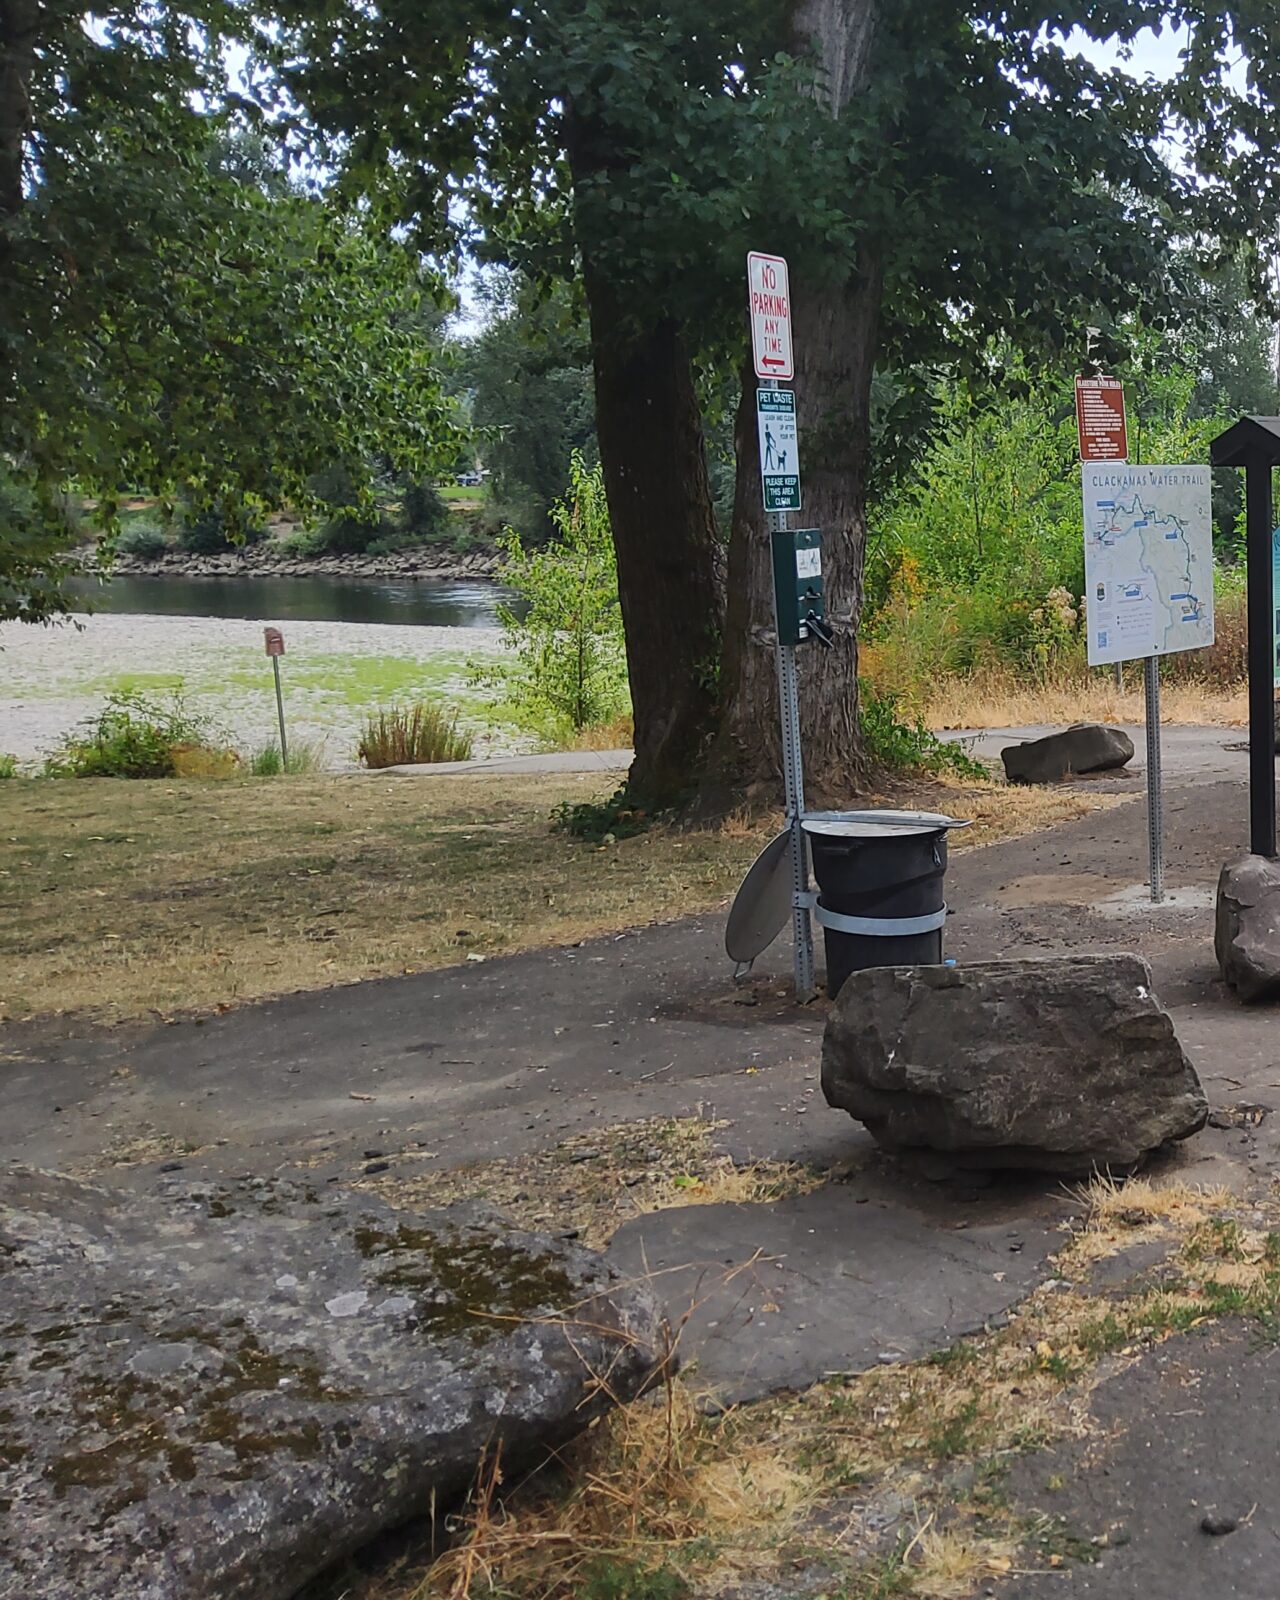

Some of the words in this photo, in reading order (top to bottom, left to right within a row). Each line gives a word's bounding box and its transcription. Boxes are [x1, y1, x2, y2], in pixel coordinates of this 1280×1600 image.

[762, 268, 775, 289] NO
[753, 293, 786, 317] PARKING
[765, 320, 778, 334] ANY
[764, 337, 781, 353] TIME
[760, 392, 770, 402] PET
[773, 393, 792, 403] WASTE
[766, 478, 783, 486] PLEASE
[1092, 475, 1147, 487] CLACKAMAS
[1150, 475, 1178, 486] WATER
[1182, 475, 1204, 486] TRAIL
